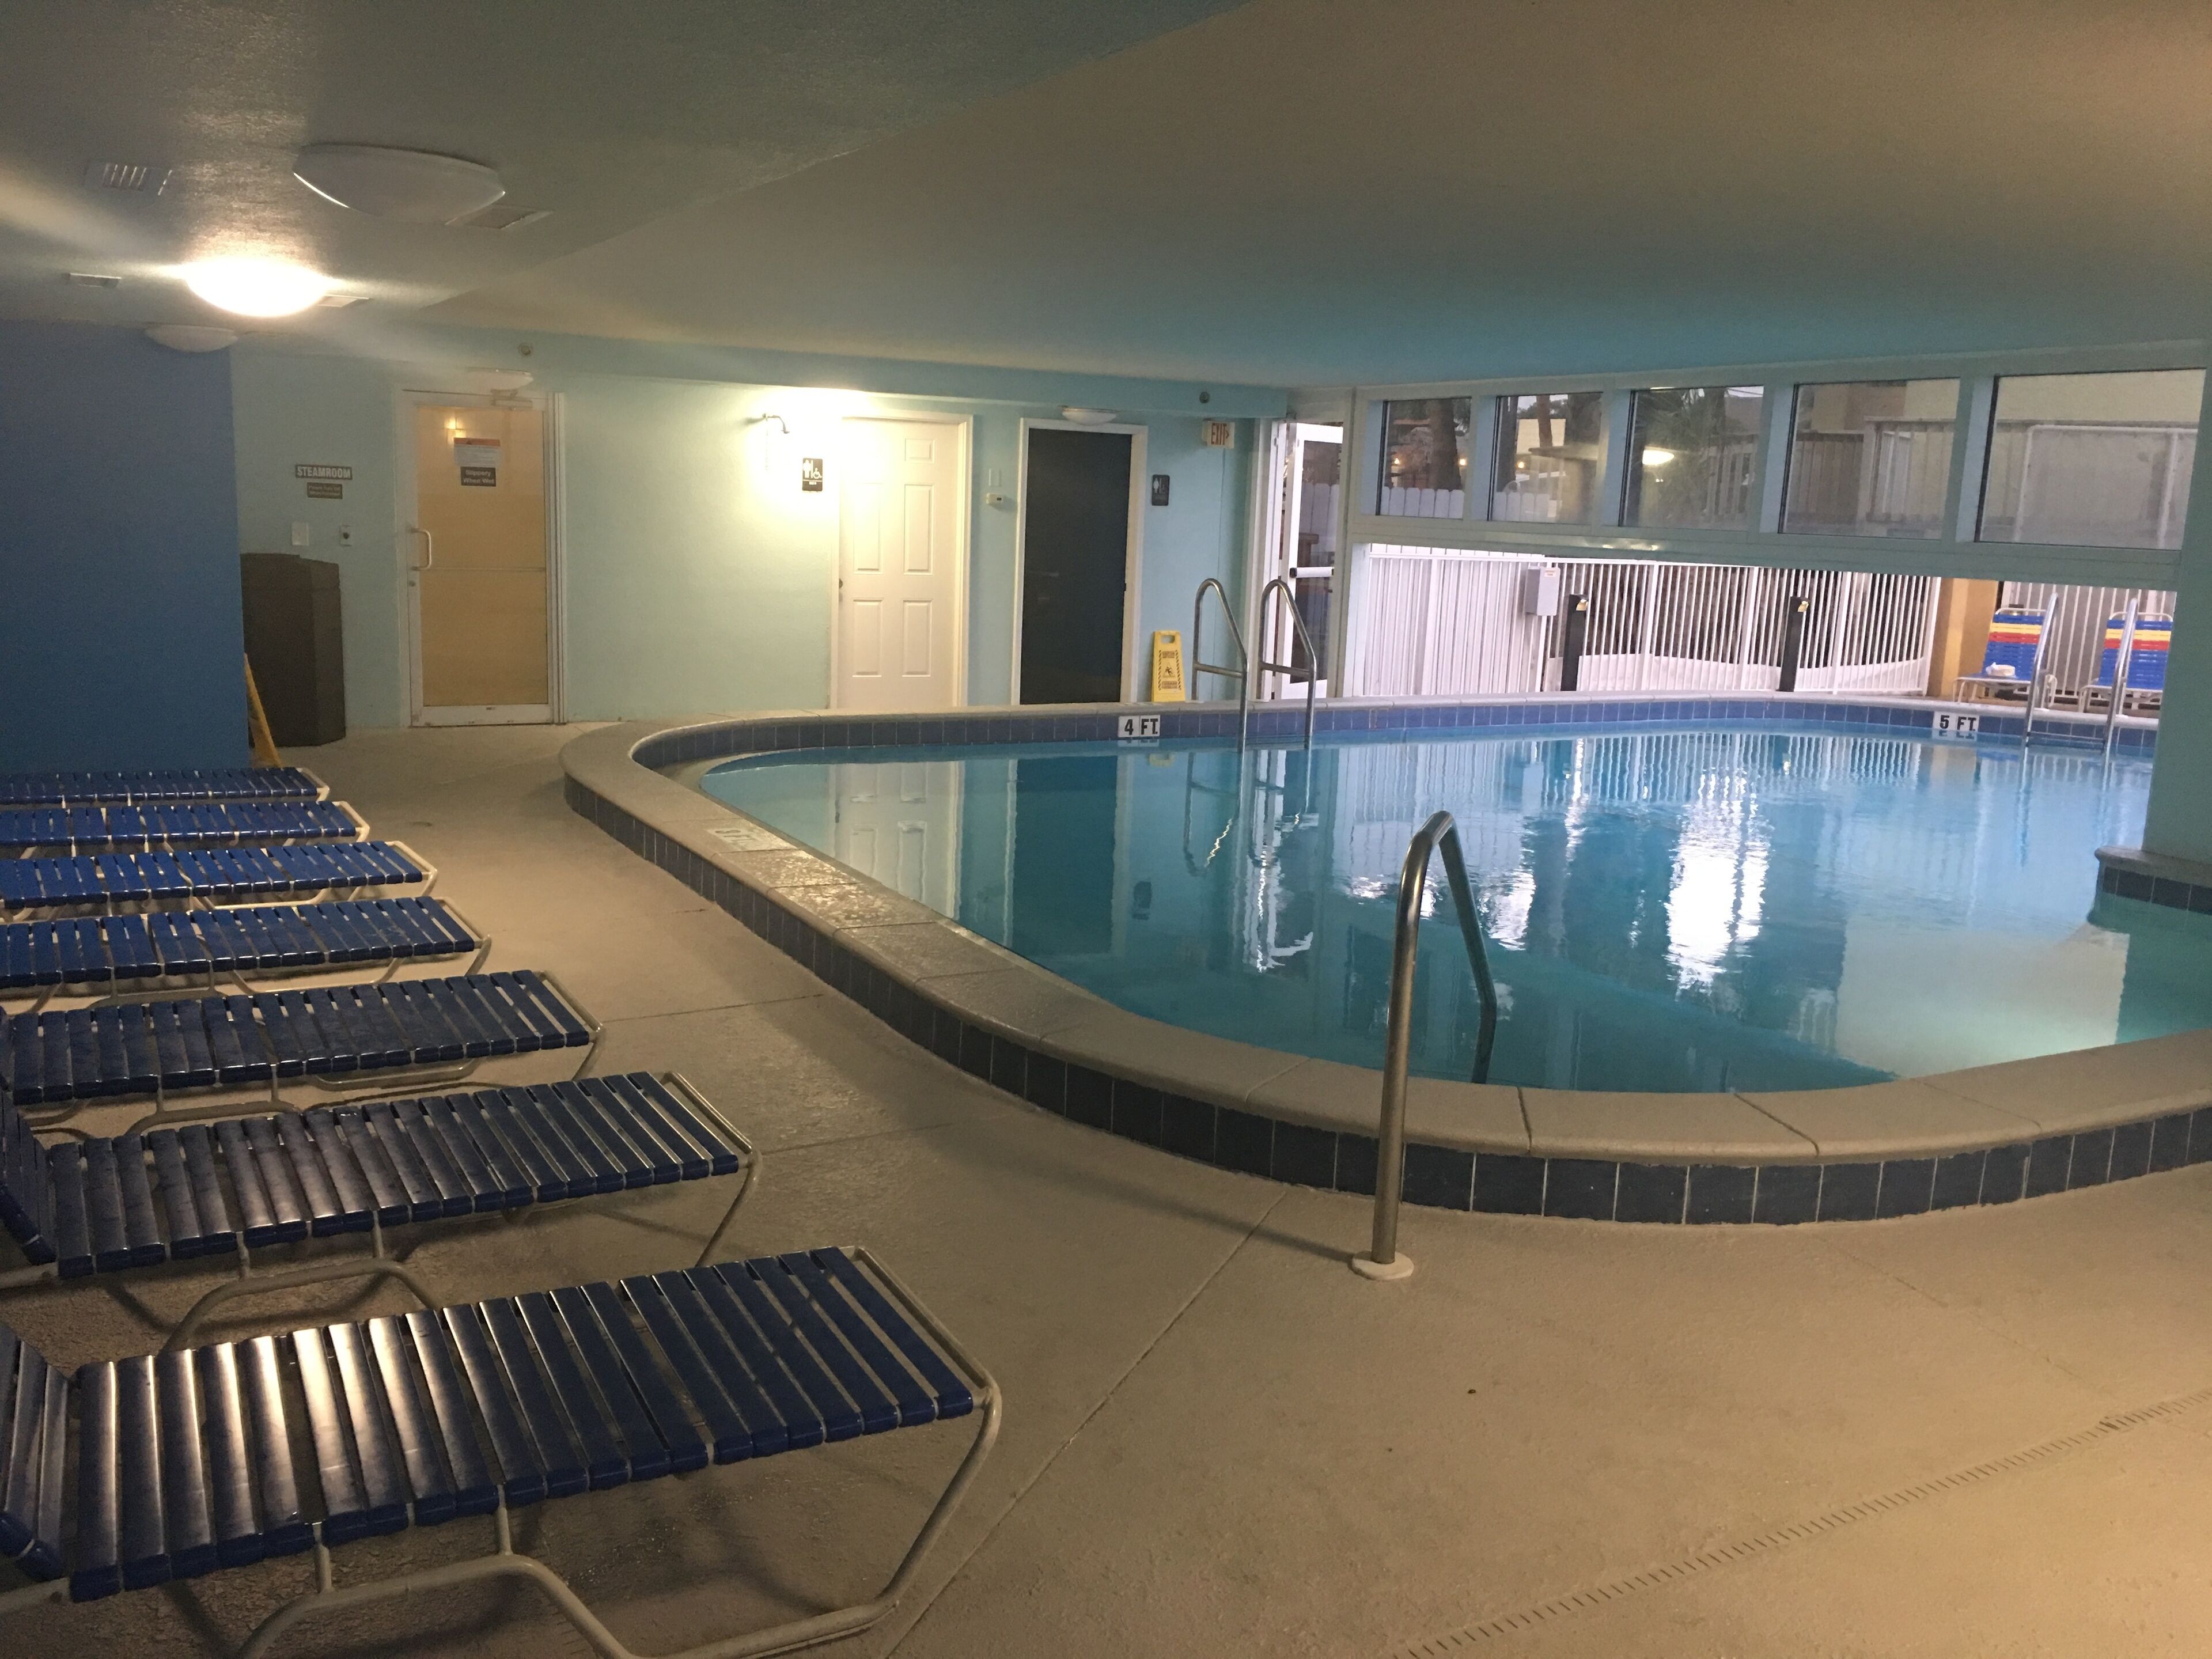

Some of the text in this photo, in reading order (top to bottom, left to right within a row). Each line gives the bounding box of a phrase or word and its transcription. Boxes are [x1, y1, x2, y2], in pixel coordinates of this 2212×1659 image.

[1211, 423, 1227, 445] EXIT
[297, 466, 351, 478] STEAMROOM
[1124, 719, 1134, 735] 4
[1940, 715, 1950, 729] 5
